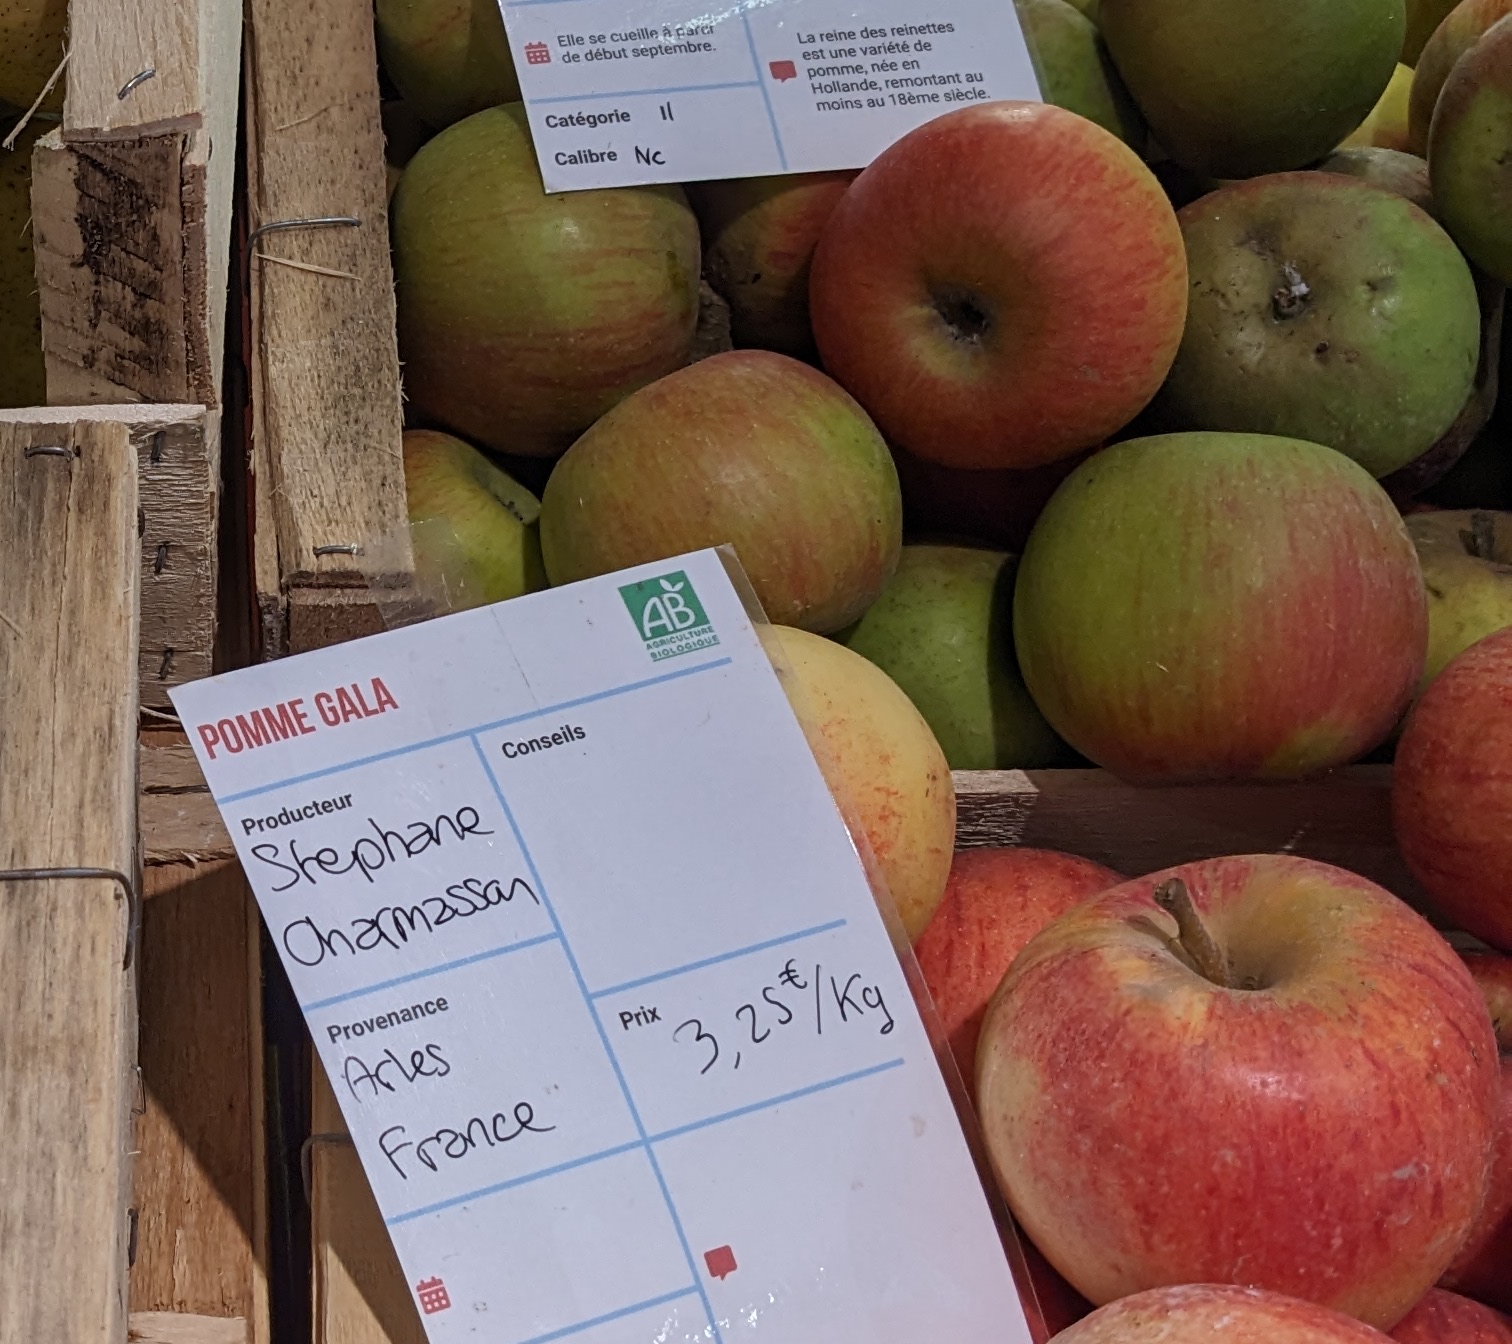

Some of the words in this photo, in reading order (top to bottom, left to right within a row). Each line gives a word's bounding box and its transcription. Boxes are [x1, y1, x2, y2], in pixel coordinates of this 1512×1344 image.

[796, 32, 816, 45] La
[819, 29, 857, 42] reine
[859, 26, 888, 40] des
[890, 23, 955, 37] reinettes
[561, 50, 581, 64] de
[584, 47, 629, 62] début
[631, 40, 717, 59] septembre.
[802, 48, 827, 61] est
[828, 47, 857, 59] une
[858, 40, 911, 56] variété
[913, 39, 933, 53] de
[806, 64, 869, 81] pomme,
[870, 59, 899, 73] née
[901, 59, 921, 71] en
[545, 108, 631, 129] Catégorie
[554, 148, 618, 166] Calibre
[642, 592, 696, 638] AB
[196, 698, 317, 760] POMME
[313, 676, 400, 727] GALA
[501, 724, 587, 759] Conseils
[240, 793, 353, 837] Producteur
[326, 997, 449, 1045] Provenance
[618, 1005, 662, 1031] Prix
[378, 1101, 557, 1181] France
